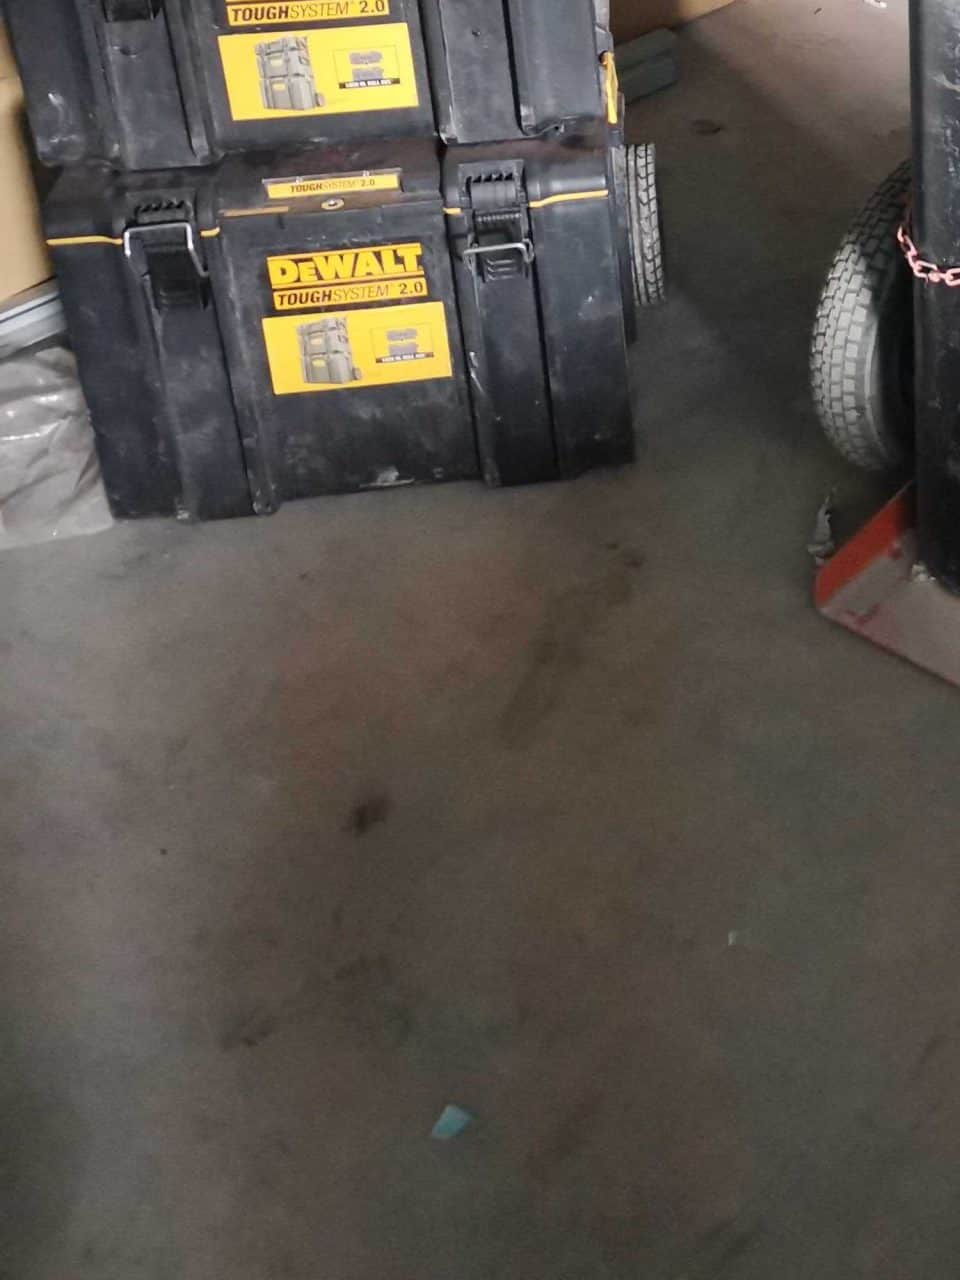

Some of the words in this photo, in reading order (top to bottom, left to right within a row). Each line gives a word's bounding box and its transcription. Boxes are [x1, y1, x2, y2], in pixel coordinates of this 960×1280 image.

[231, 2, 349, 22] TOUGHSYSTEM
[359, 0, 385, 14] 2.0
[361, 178, 376, 187] 2.0
[278, 284, 389, 306] TOUGHSYSTEM
[399, 281, 423, 295] 2.0
